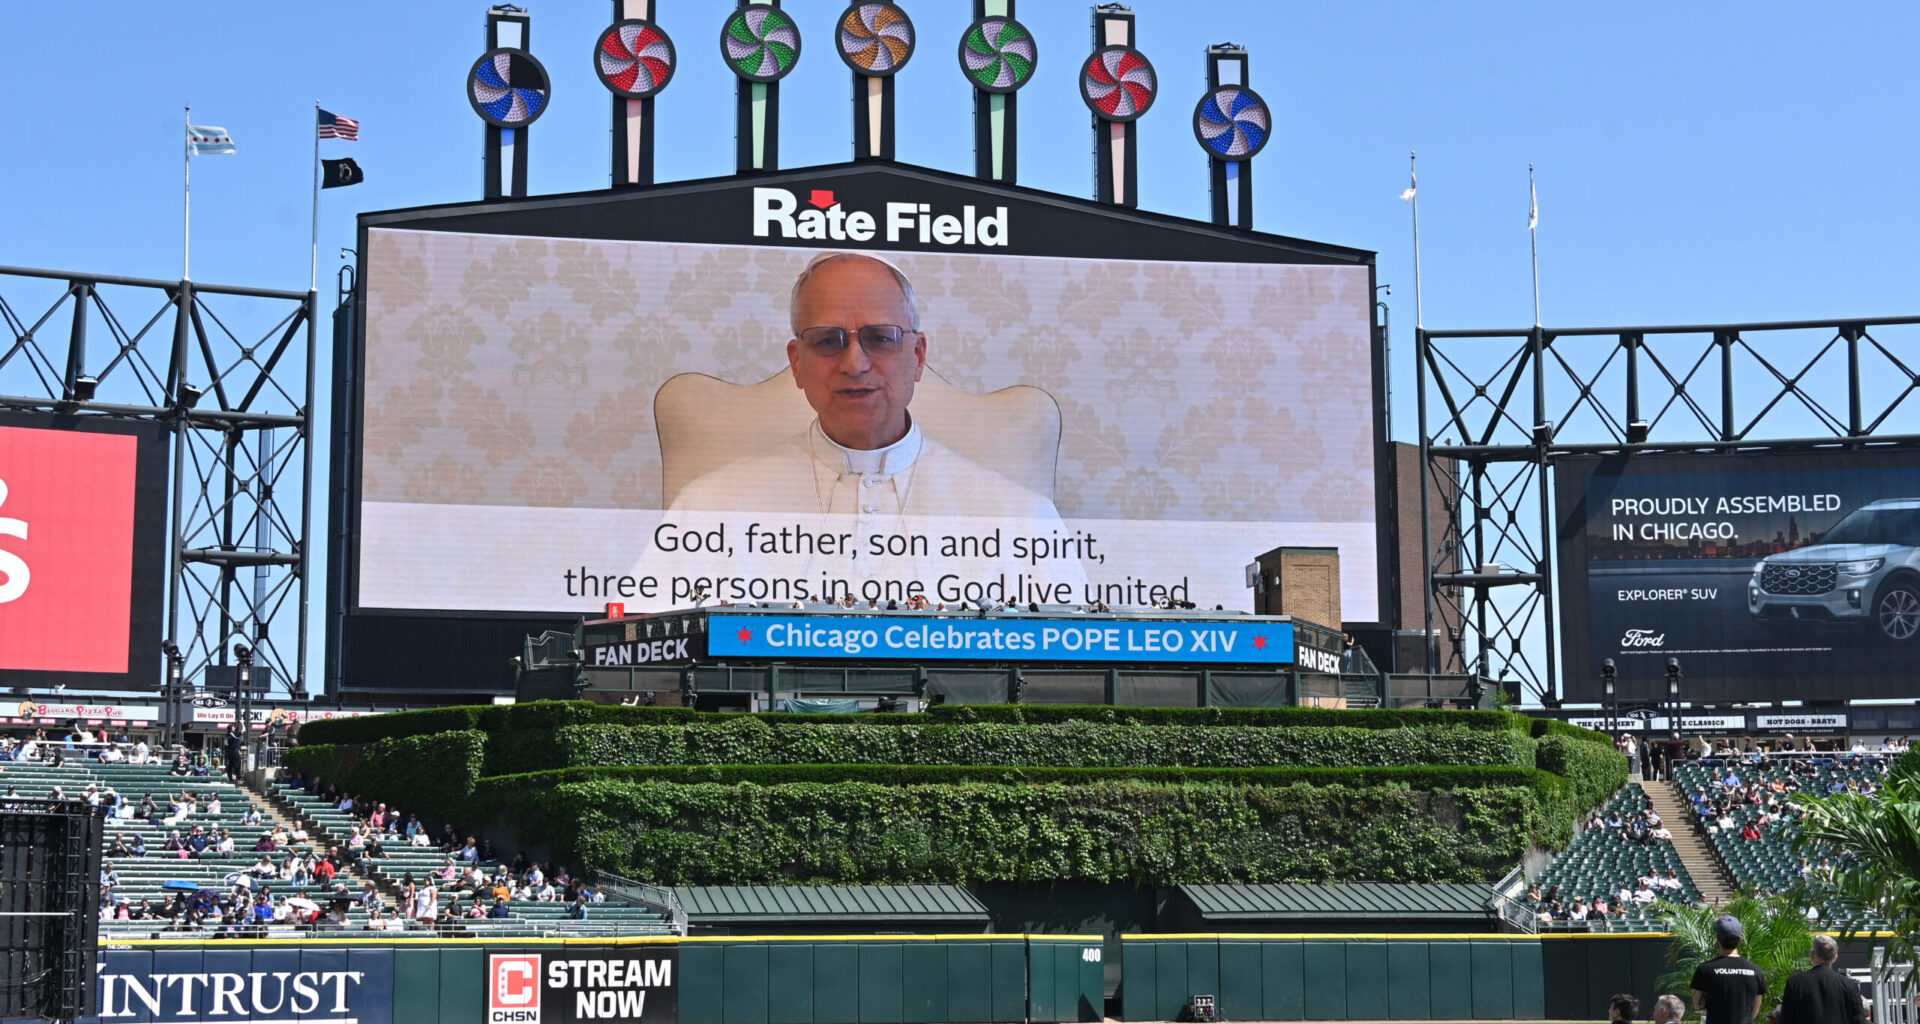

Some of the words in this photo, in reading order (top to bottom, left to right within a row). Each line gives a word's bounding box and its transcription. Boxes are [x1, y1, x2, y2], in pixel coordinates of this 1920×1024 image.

[753, 187, 876, 241] Rate
[887, 202, 1008, 246] Field
[1612, 497, 1709, 515] PROUDLY
[1715, 494, 1841, 514] ASSEMBLED
[654, 523, 733, 557] God,
[745, 523, 857, 559] father,
[870, 534, 928, 556] son
[941, 528, 1000, 557] and
[1013, 530, 1105, 565] spirit,
[1612, 523, 1634, 541] IN
[1640, 521, 1739, 541] CHICAGO.
[564, 566, 658, 597] three
[672, 574, 809, 605] persons
[822, 571, 849, 602] in
[862, 579, 925, 602] one
[937, 574, 1004, 603] God
[1018, 574, 1072, 604] live
[1085, 576, 1188, 606] united
[1691, 588, 1718, 600] SUV
[595, 642, 632, 666] FAN
[637, 637, 689, 663] DECK
[766, 624, 878, 653] Chicago
[884, 625, 1036, 650] Celebrates
[1042, 628, 1120, 651] POPE
[1127, 629, 1184, 652] LEO
[1189, 631, 1238, 653] XIV
[1621, 629, 1664, 647] Ford
[1299, 645, 1317, 670] FAN
[1318, 650, 1340, 674] DECK
[208, 712, 219, 720] Lay
[1082, 948, 1101, 962] 400
[548, 960, 672, 988] STREAM
[1713, 968, 1755, 976] VOLUNTEER
[97, 964, 361, 1017] INTRUST
[492, 1011, 537, 1022] CHSN
[576, 991, 646, 1019] NOW
